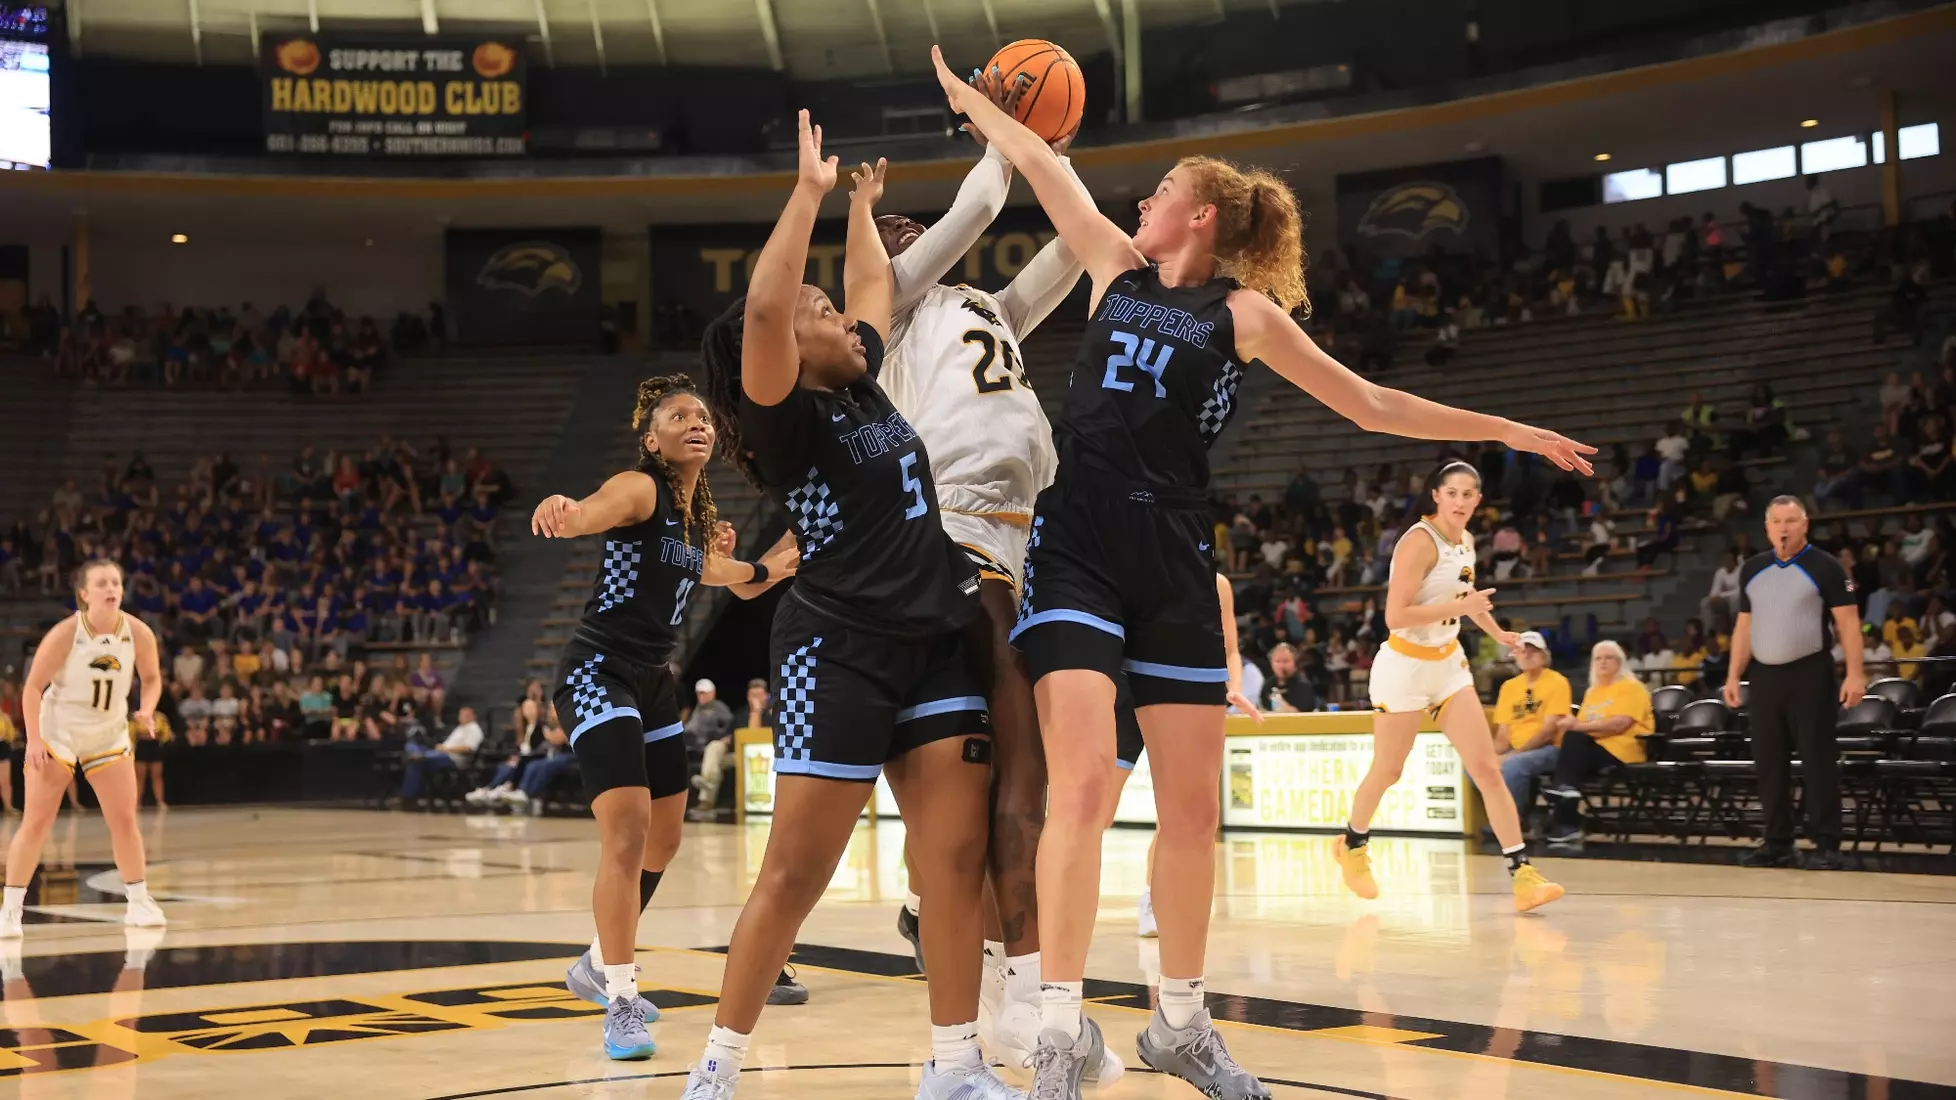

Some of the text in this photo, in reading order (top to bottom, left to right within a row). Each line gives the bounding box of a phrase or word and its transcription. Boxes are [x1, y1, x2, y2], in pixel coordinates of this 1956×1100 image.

[329, 48, 464, 72] SUPPORT THE
[271, 77, 521, 115] HARDWOOD CLUB
[1099, 293, 1215, 349] TOPPERS
[1101, 330, 1175, 399] 24
[899, 451, 928, 520] 5
[92, 678, 113, 711] 11
[1260, 757, 1358, 785] SOUTHERN
[1426, 761, 1455, 775] TODAY
[1260, 787, 1356, 824] GAMEDA
